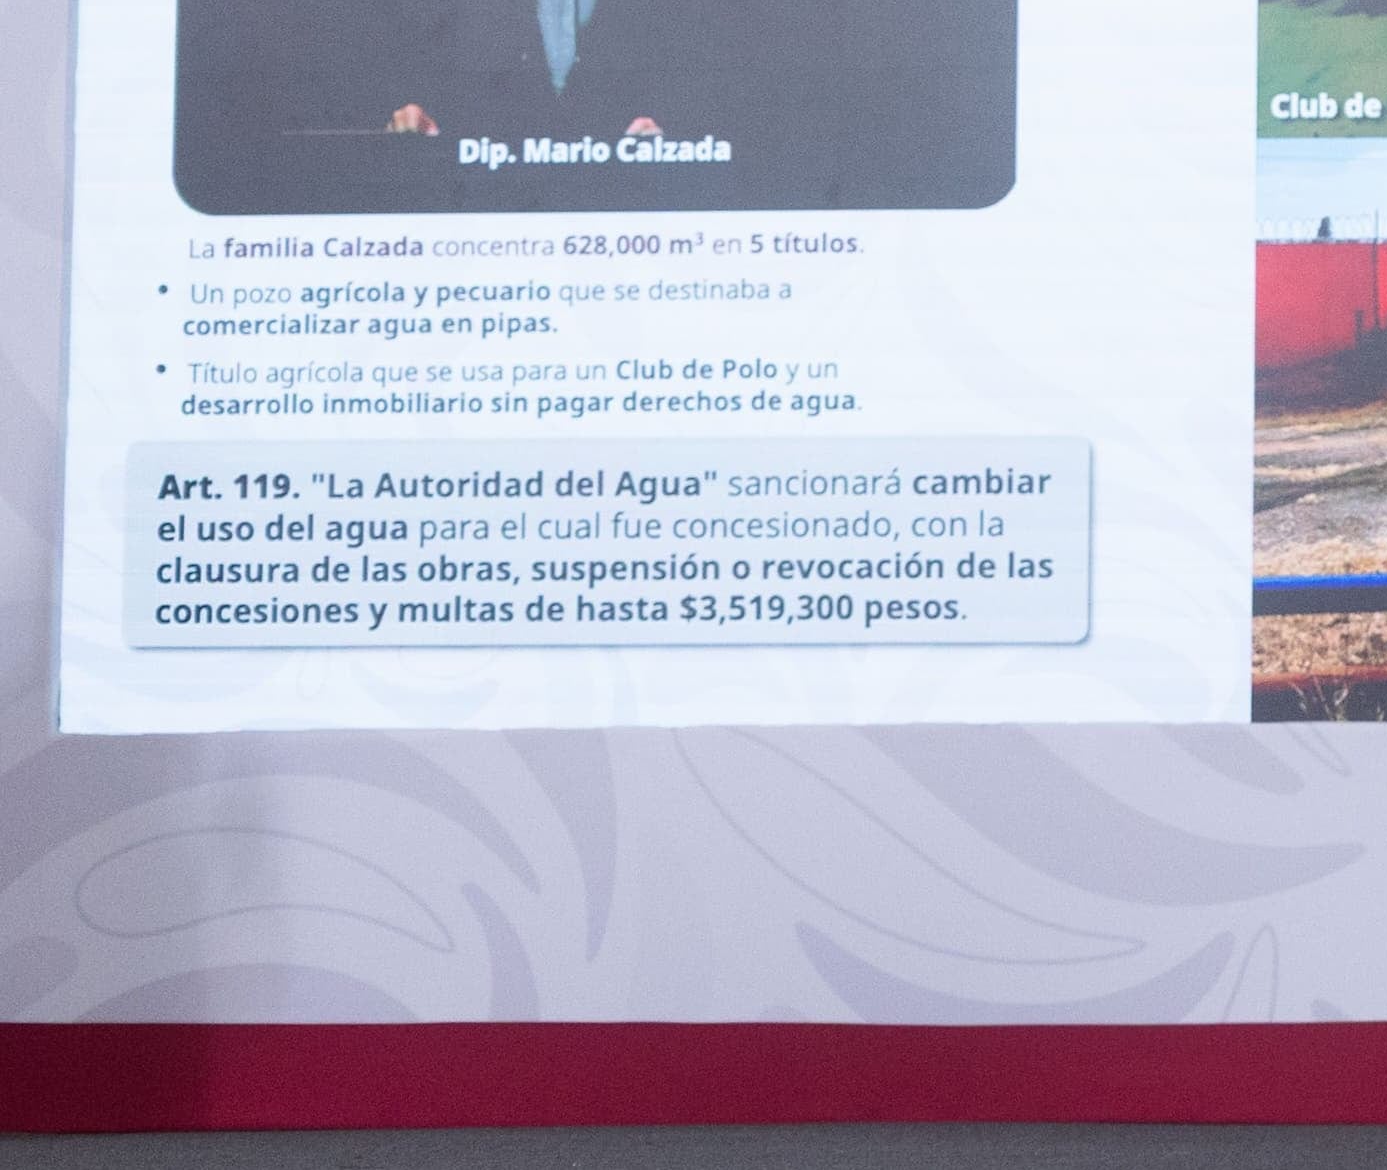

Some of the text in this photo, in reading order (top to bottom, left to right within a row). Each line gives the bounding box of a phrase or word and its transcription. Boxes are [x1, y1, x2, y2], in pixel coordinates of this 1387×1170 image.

[1270, 92, 1337, 119] Club
[1345, 92, 1382, 119] de
[458, 134, 732, 169] Dip. Mario Calzada
[189, 238, 215, 259] La
[224, 238, 314, 259] familia
[324, 237, 424, 258] Calzada
[432, 237, 556, 257] concentra
[562, 235, 661, 258] 628,000
[712, 236, 742, 254] en
[750, 234, 764, 253] 5
[773, 232, 865, 254] títulos.
[190, 279, 793, 310] Un pozo agrícola y pecuario que se destinaba a
[183, 313, 558, 340] comercializar agua en pipas.
[189, 358, 839, 388] Título agrícola que se usa para un Club de Polo y un
[181, 390, 863, 418] desarrollo inmobiliario sin pagar derechos de agua.
[157, 467, 1052, 505] Art. 119. "La Autoridad del Agua" sancionará cambiar
[157, 509, 1005, 549] el uso del agua para el cual fue concesionado, con la
[157, 551, 1053, 589] clausura de las obras, suspensión o revocación de las
[156, 593, 967, 631] concesiones y multas de hasta $3,519,300 pesos.
